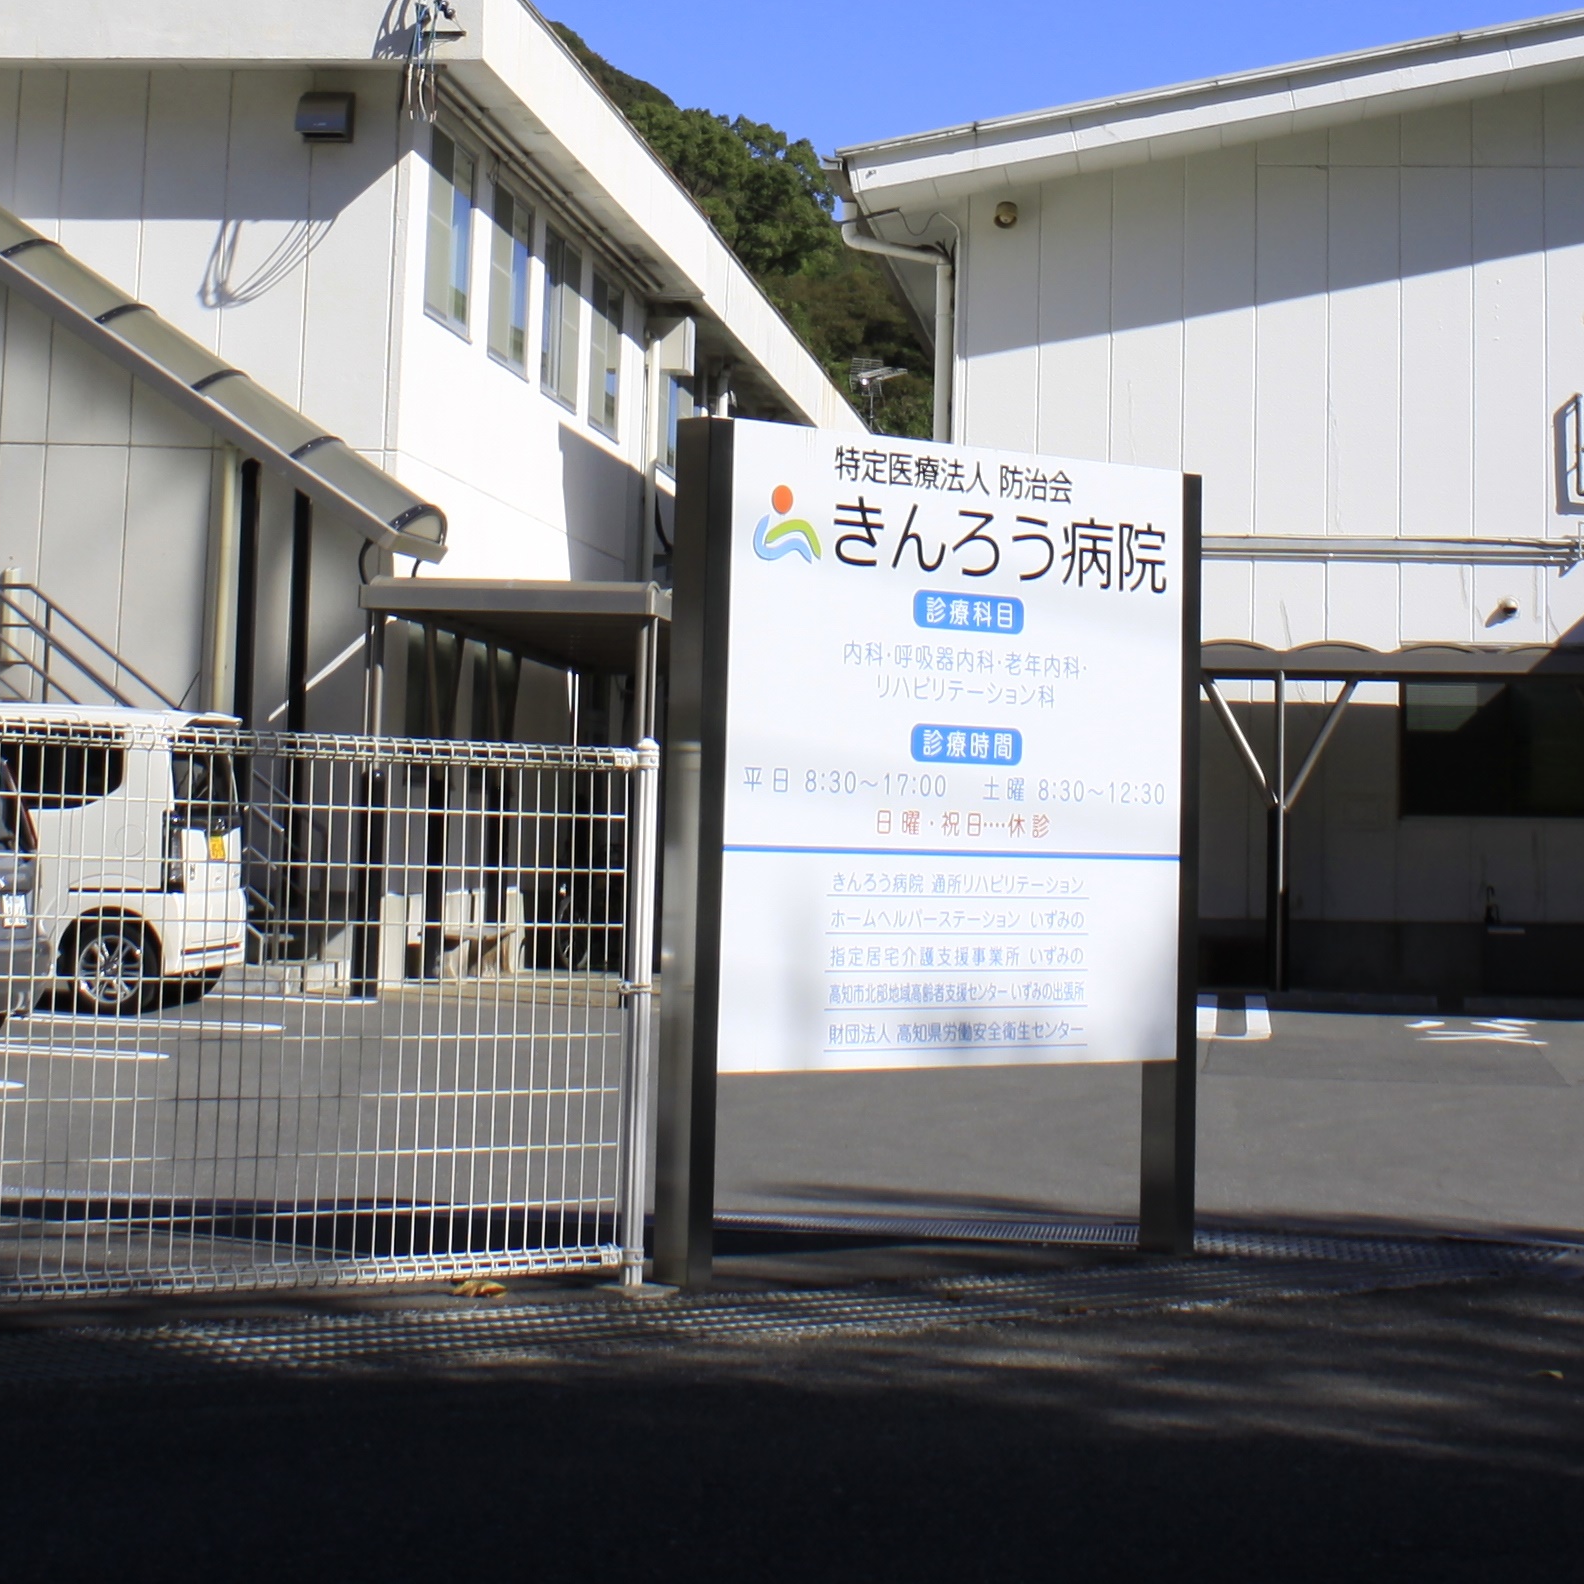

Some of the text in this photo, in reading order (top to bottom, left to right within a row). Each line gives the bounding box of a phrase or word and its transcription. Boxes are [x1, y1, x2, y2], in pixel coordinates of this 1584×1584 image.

[835, 445, 1073, 504] 特定医療法人 防治会
[833, 495, 1167, 595] きんろう病院
[925, 596, 1014, 629] 診療科目
[877, 674, 1055, 709] リハビリテーション科
[922, 728, 1013, 760] 診療時間
[743, 766, 790, 794] 平日
[982, 775, 1025, 803] 土曜
[831, 872, 1084, 895] きんろう病院 通所リハビリテーション
[830, 908, 1085, 930] ホームヘルパーステーション いずみの
[829, 944, 1084, 968] 指定居宅介護支援事業所 いずみの
[1010, 980, 1085, 1003] いずみの出張所
[828, 1019, 1085, 1045] 財団法人 高知県労働安全衛生センター
